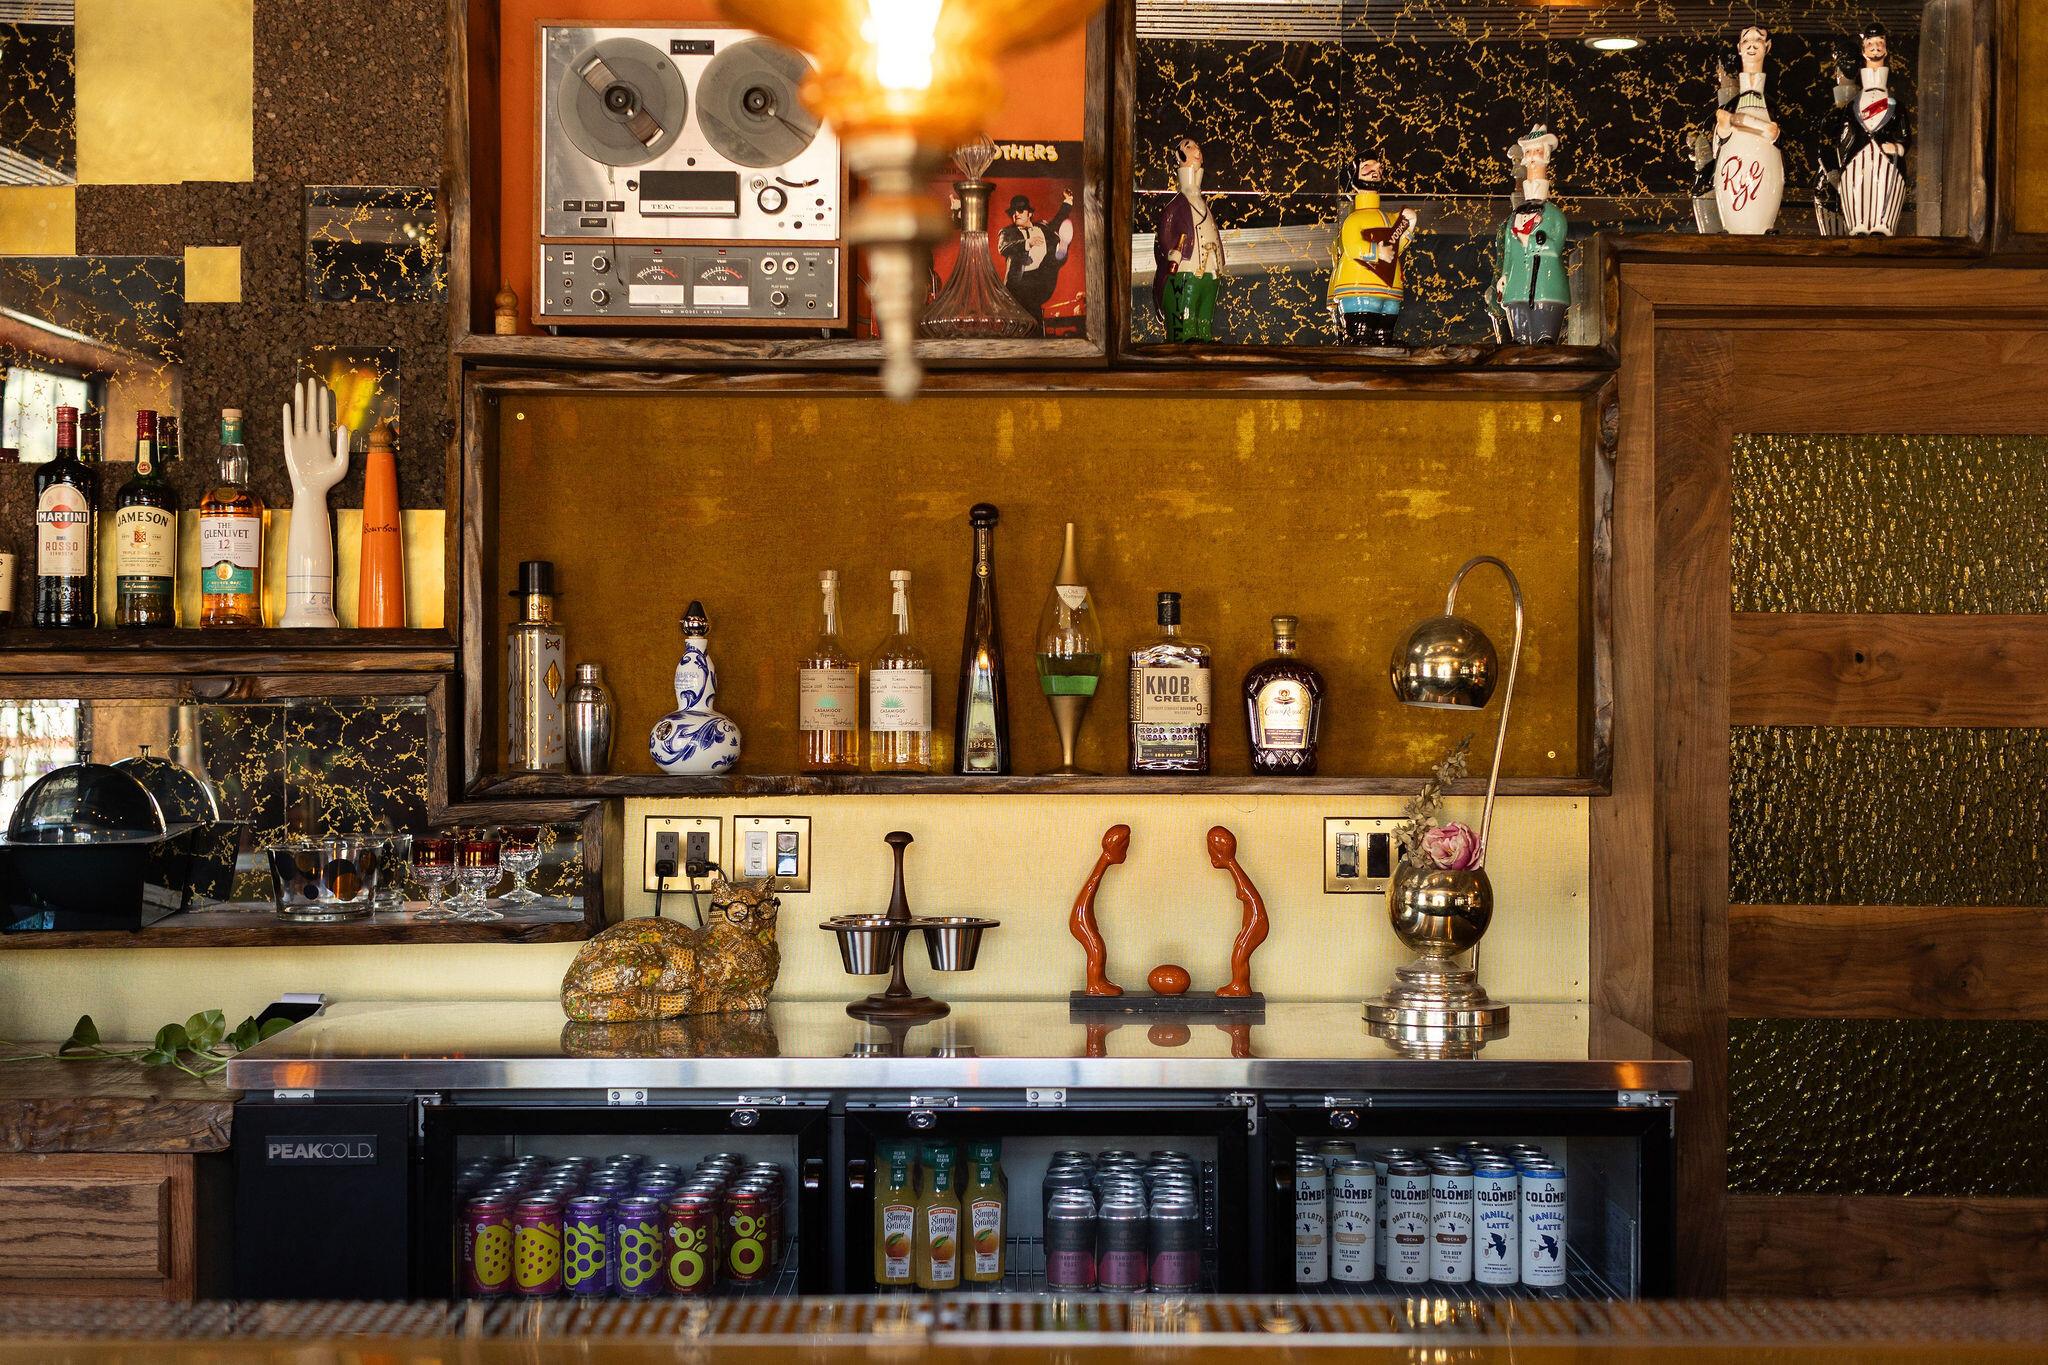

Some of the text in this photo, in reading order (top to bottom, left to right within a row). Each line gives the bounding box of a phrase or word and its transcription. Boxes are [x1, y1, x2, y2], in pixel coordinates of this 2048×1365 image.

[993, 144, 1059, 162] OTHERS
[1721, 156, 1765, 212] Rye
[1389, 218, 1409, 244] VODKA
[1170, 279, 1187, 344] WINE
[39, 512, 87, 522] MARTINI
[117, 511, 169, 528] JAMESON
[204, 529, 249, 539] GLENLIVET
[364, 523, 398, 534] Bourbon
[45, 541, 79, 551] ROSSO
[219, 539, 231, 549] 12
[1146, 676, 1190, 695] KNOB
[1196, 703, 1203, 716] 9
[968, 741, 995, 749] 1942
[268, 1143, 372, 1159] PEAKCOLD
[1301, 1181, 1311, 1190] La
[1344, 1179, 1354, 1188] La
[1407, 1181, 1416, 1189] La
[1447, 1180, 1457, 1189] La
[1492, 1182, 1501, 1191] La
[1545, 1182, 1555, 1192] La
[1296, 1189, 1325, 1201] LOMBE
[1333, 1189, 1373, 1200] COLOMBE
[1390, 1189, 1430, 1200] COLOMBE
[1432, 1188, 1473, 1200] COLOMBE
[1477, 1190, 1517, 1201] COLOMBE
[886, 1212, 911, 1222] Simply
[974, 1208, 998, 1219] Simply
[1307, 1212, 1325, 1224] LATTE
[1350, 1210, 1371, 1225] LATTE
[1392, 1211, 1429, 1224] DRAFT LATTE
[1433, 1211, 1471, 1224] DRAFT LATTE
[885, 1220, 911, 1231] Orange
[931, 1215, 955, 1226] Simply
[974, 1217, 998, 1228] Orange
[930, 1223, 955, 1235] Orange
